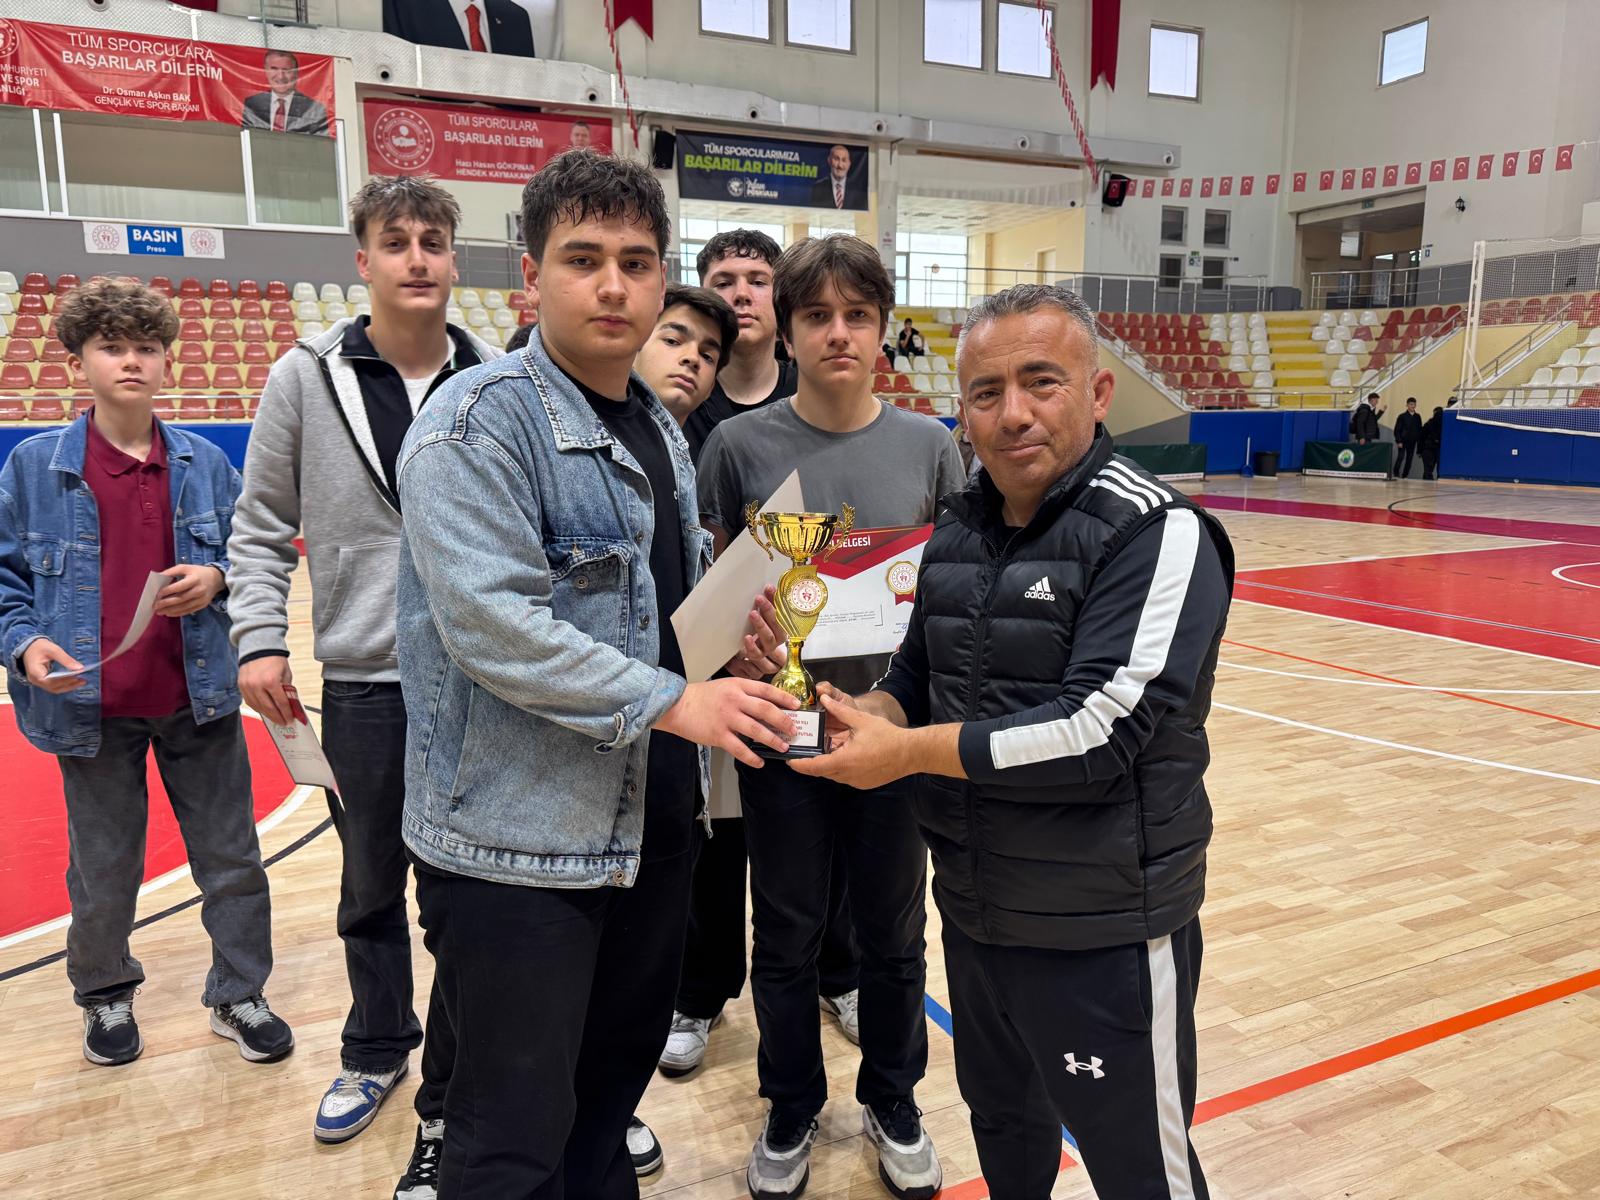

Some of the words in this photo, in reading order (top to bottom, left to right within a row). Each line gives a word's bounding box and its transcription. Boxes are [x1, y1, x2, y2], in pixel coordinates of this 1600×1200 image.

[67, 32, 102, 50] TÜM
[108, 38, 216, 62] SPORCULARA
[62, 51, 157, 73] BAŞARILAR
[161, 59, 224, 81] DİLERİM
[0, 73, 13, 83] VE
[14, 75, 40, 87] SPOR
[0, 84, 25, 96] NLIĞI
[103, 86, 115, 95] Dr.
[117, 87, 146, 98] Osman
[147, 90, 171, 100] Aşkın
[172, 93, 191, 102] BAK
[95, 96, 132, 107] GENÇLİK
[133, 100, 145, 108] VE
[146, 101, 170, 111] SPOR
[447, 113, 470, 126] TÜM
[472, 116, 539, 132] SPORCULARA
[444, 130, 503, 145] BAŞARILAR
[504, 134, 544, 149] DİLERİM
[704, 143, 723, 155] TÜM
[724, 146, 800, 161] SPORCULARIMIZA
[684, 154, 762, 174] BAŞARILAR
[764, 160, 818, 178] DİLERİM
[132, 229, 178, 244] BASIN
[146, 245, 166, 253] Press
[1024, 590, 1056, 602] adidas
